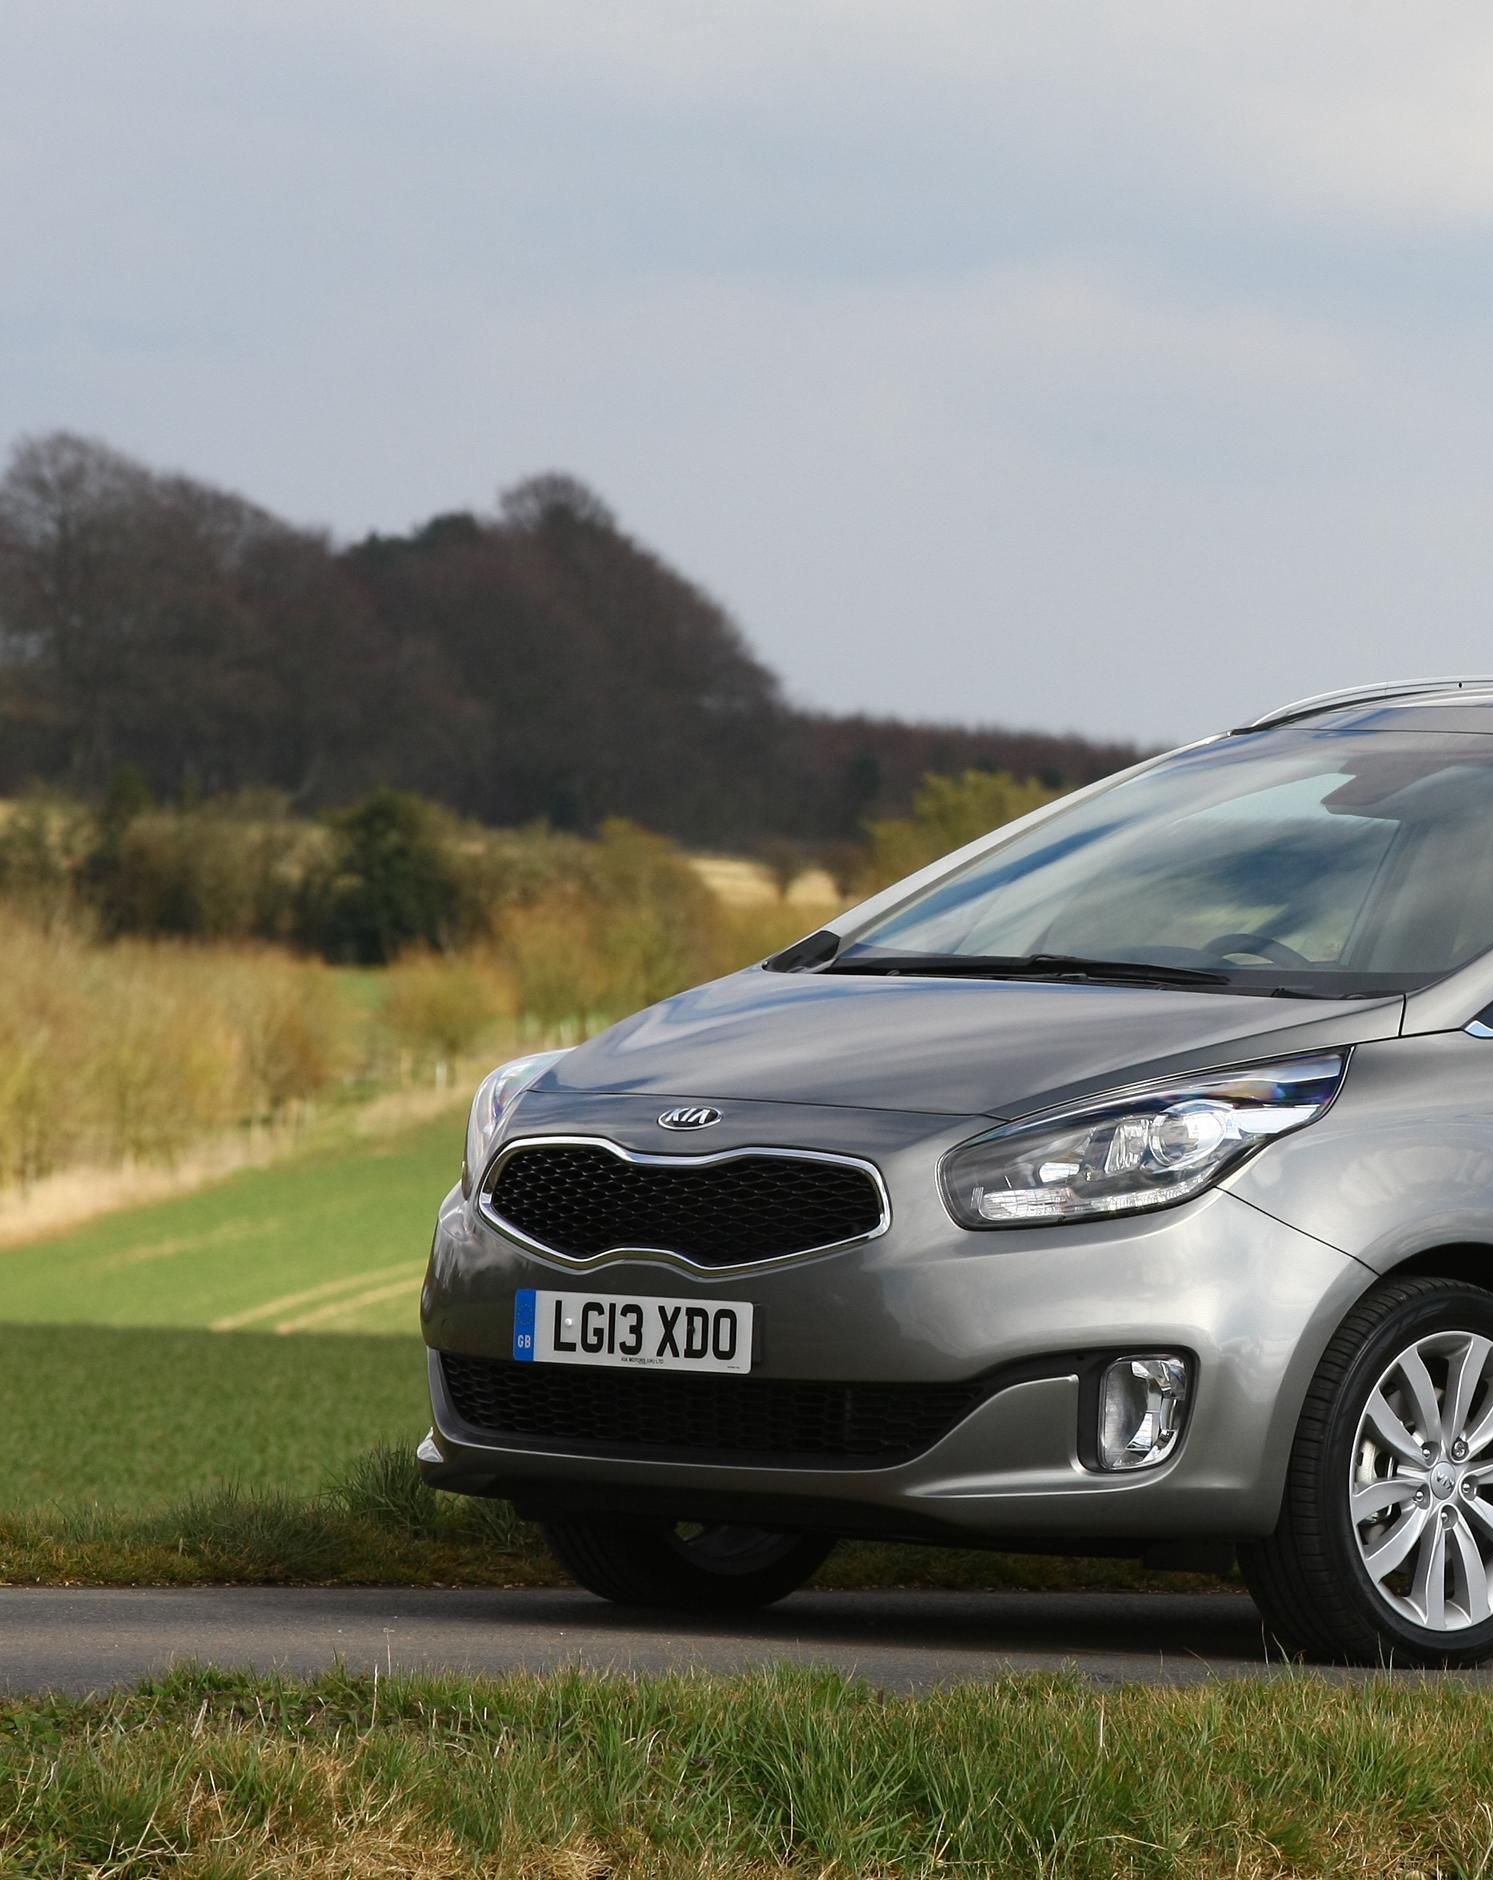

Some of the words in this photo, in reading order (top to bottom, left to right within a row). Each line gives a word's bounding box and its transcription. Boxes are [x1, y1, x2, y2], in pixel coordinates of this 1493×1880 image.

[664, 1107, 711, 1124] KIA
[553, 1300, 644, 1356] LG13
[656, 1305, 738, 1361] XDO
[517, 1334, 531, 1348] GB
